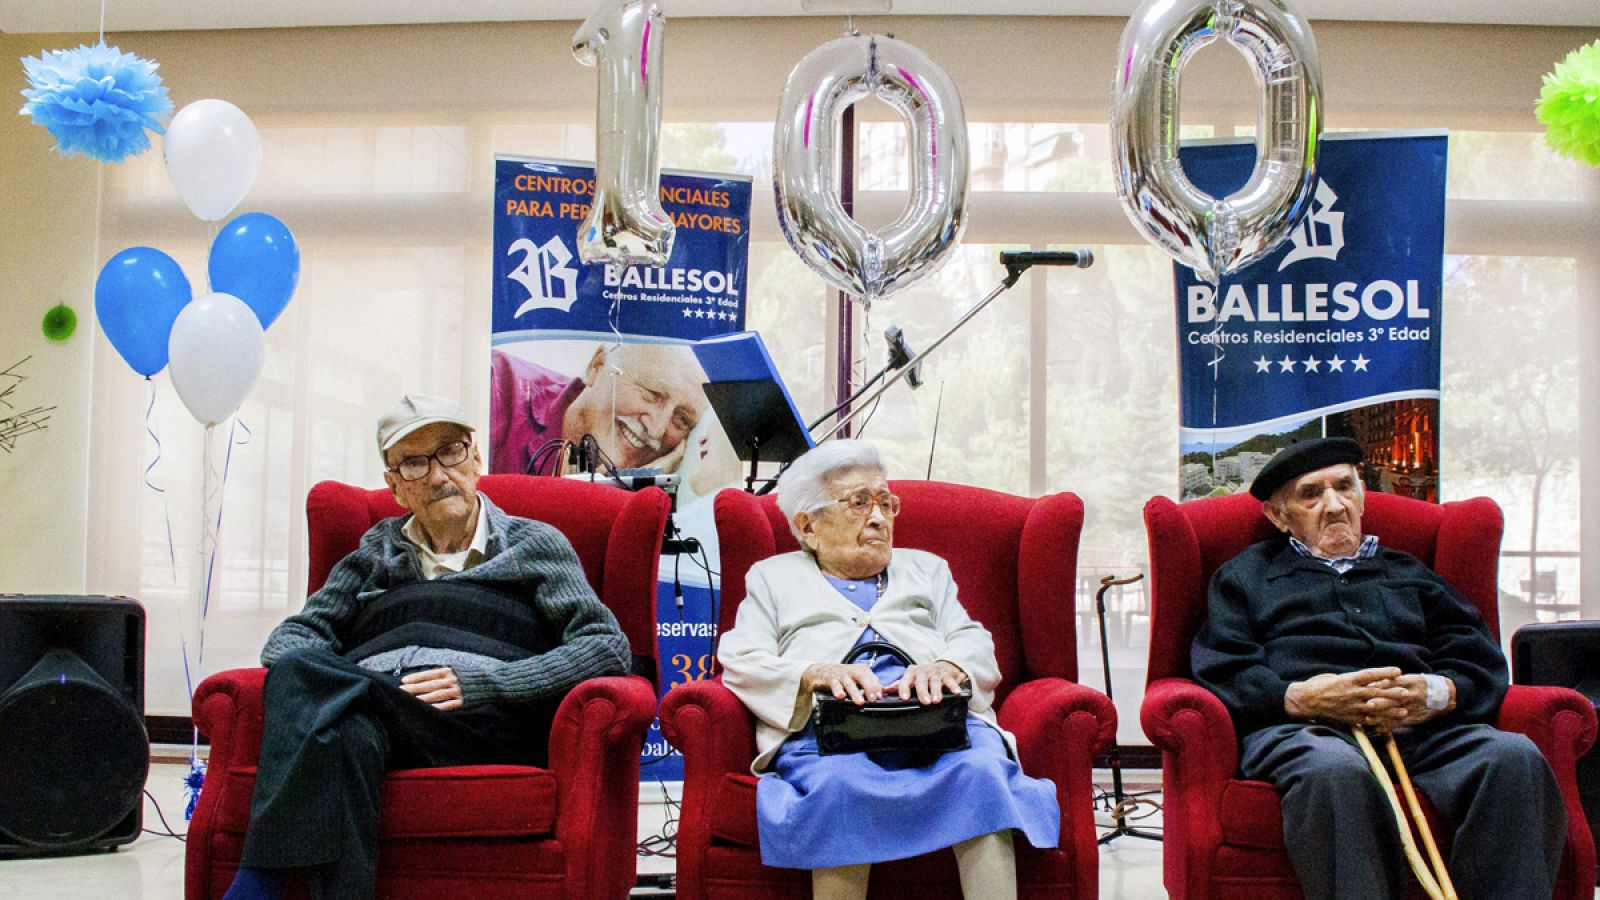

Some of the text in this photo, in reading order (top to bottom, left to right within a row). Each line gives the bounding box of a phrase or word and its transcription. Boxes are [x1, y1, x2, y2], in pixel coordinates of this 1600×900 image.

[514, 174, 730, 208] CENTROS NCIALES
[506, 199, 554, 218] PARA
[604, 263, 739, 296] BALLESOL
[640, 291, 703, 305] Residenciales
[717, 298, 739, 309] Edad
[1187, 279, 1430, 323] BALLESOL
[1188, 330, 1249, 344] Centros
[1253, 328, 1364, 344] Residenciales
[1388, 326, 1430, 341] Edad
